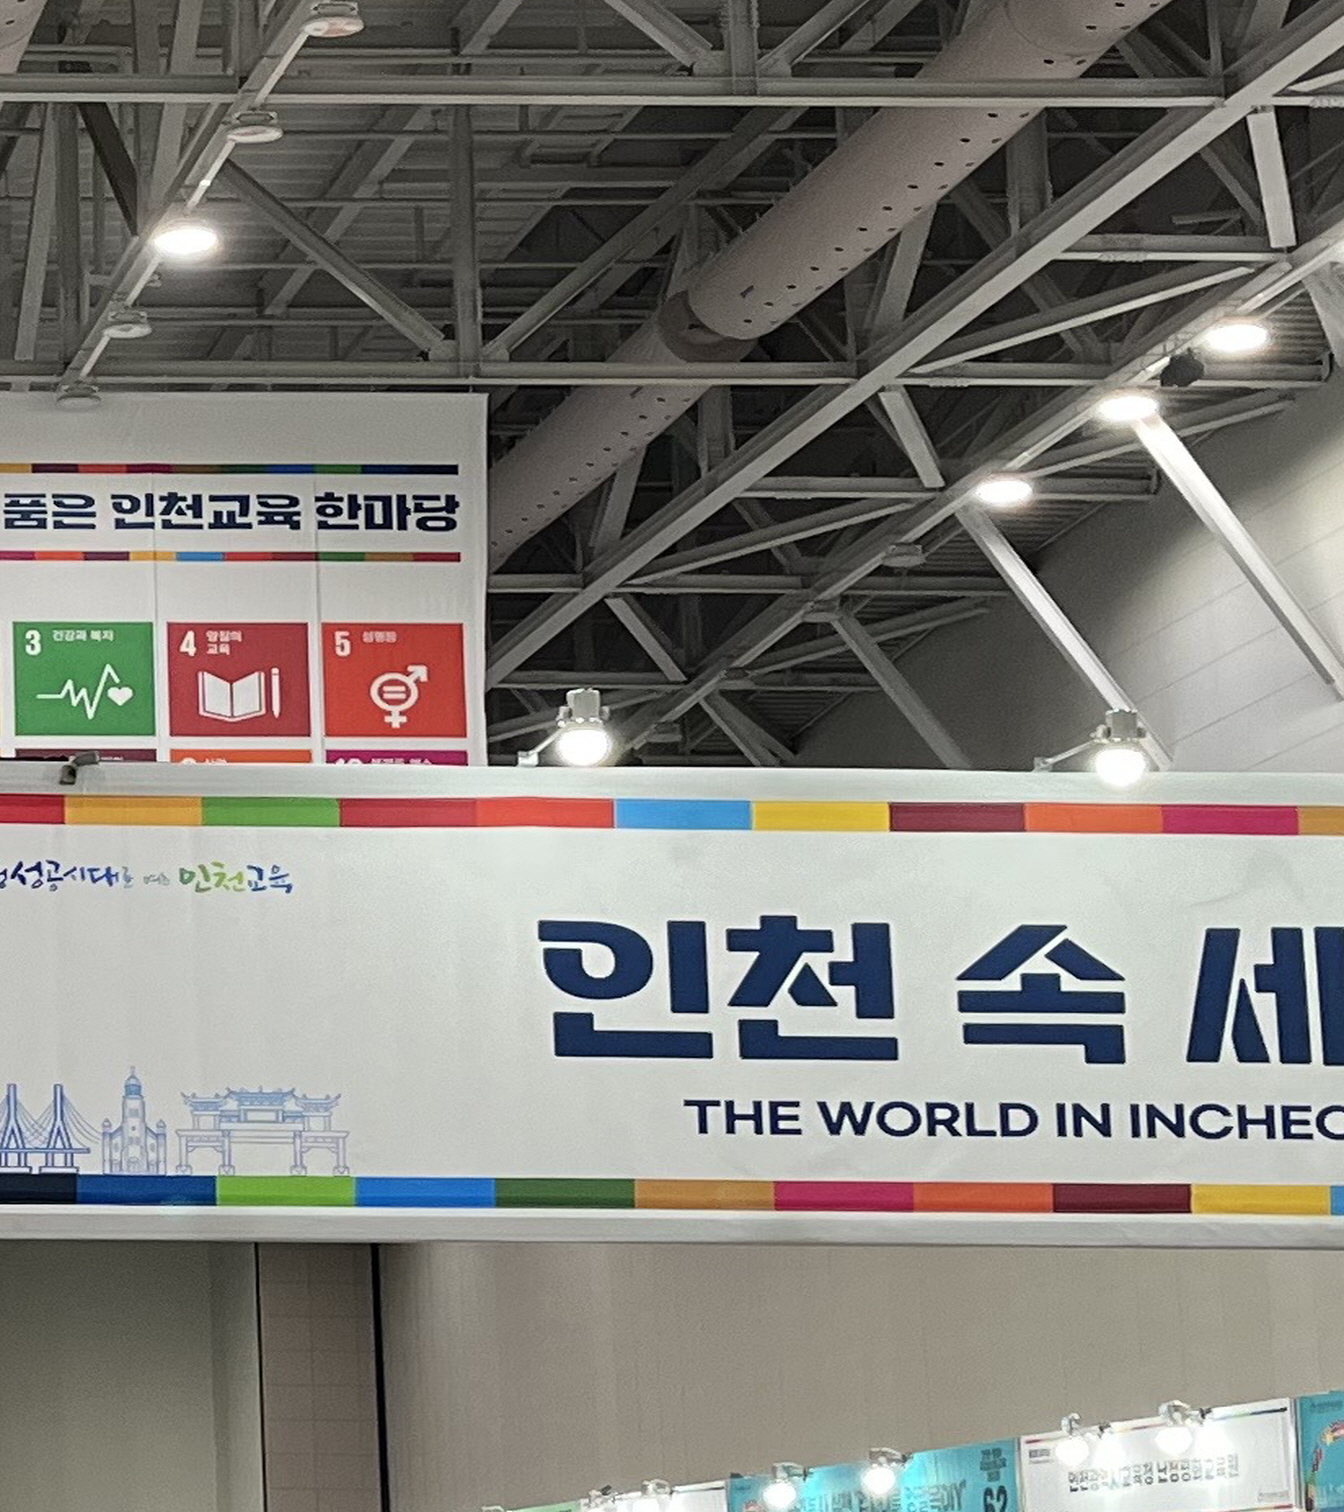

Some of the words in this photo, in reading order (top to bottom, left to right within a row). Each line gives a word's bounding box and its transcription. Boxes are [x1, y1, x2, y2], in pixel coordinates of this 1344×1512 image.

[3, 492, 96, 530] 품은
[110, 492, 301, 531] 인천교육
[314, 492, 460, 532] 한마당
[25, 630, 42, 655] 3
[179, 631, 197, 656] 4
[335, 631, 351, 656] 5
[178, 861, 294, 893] 인천교육
[537, 916, 899, 1061] 인천
[956, 924, 1126, 1064] 속
[684, 1098, 802, 1136] THE
[819, 1100, 1039, 1139] WORLD
[1056, 1101, 1112, 1138] IN
